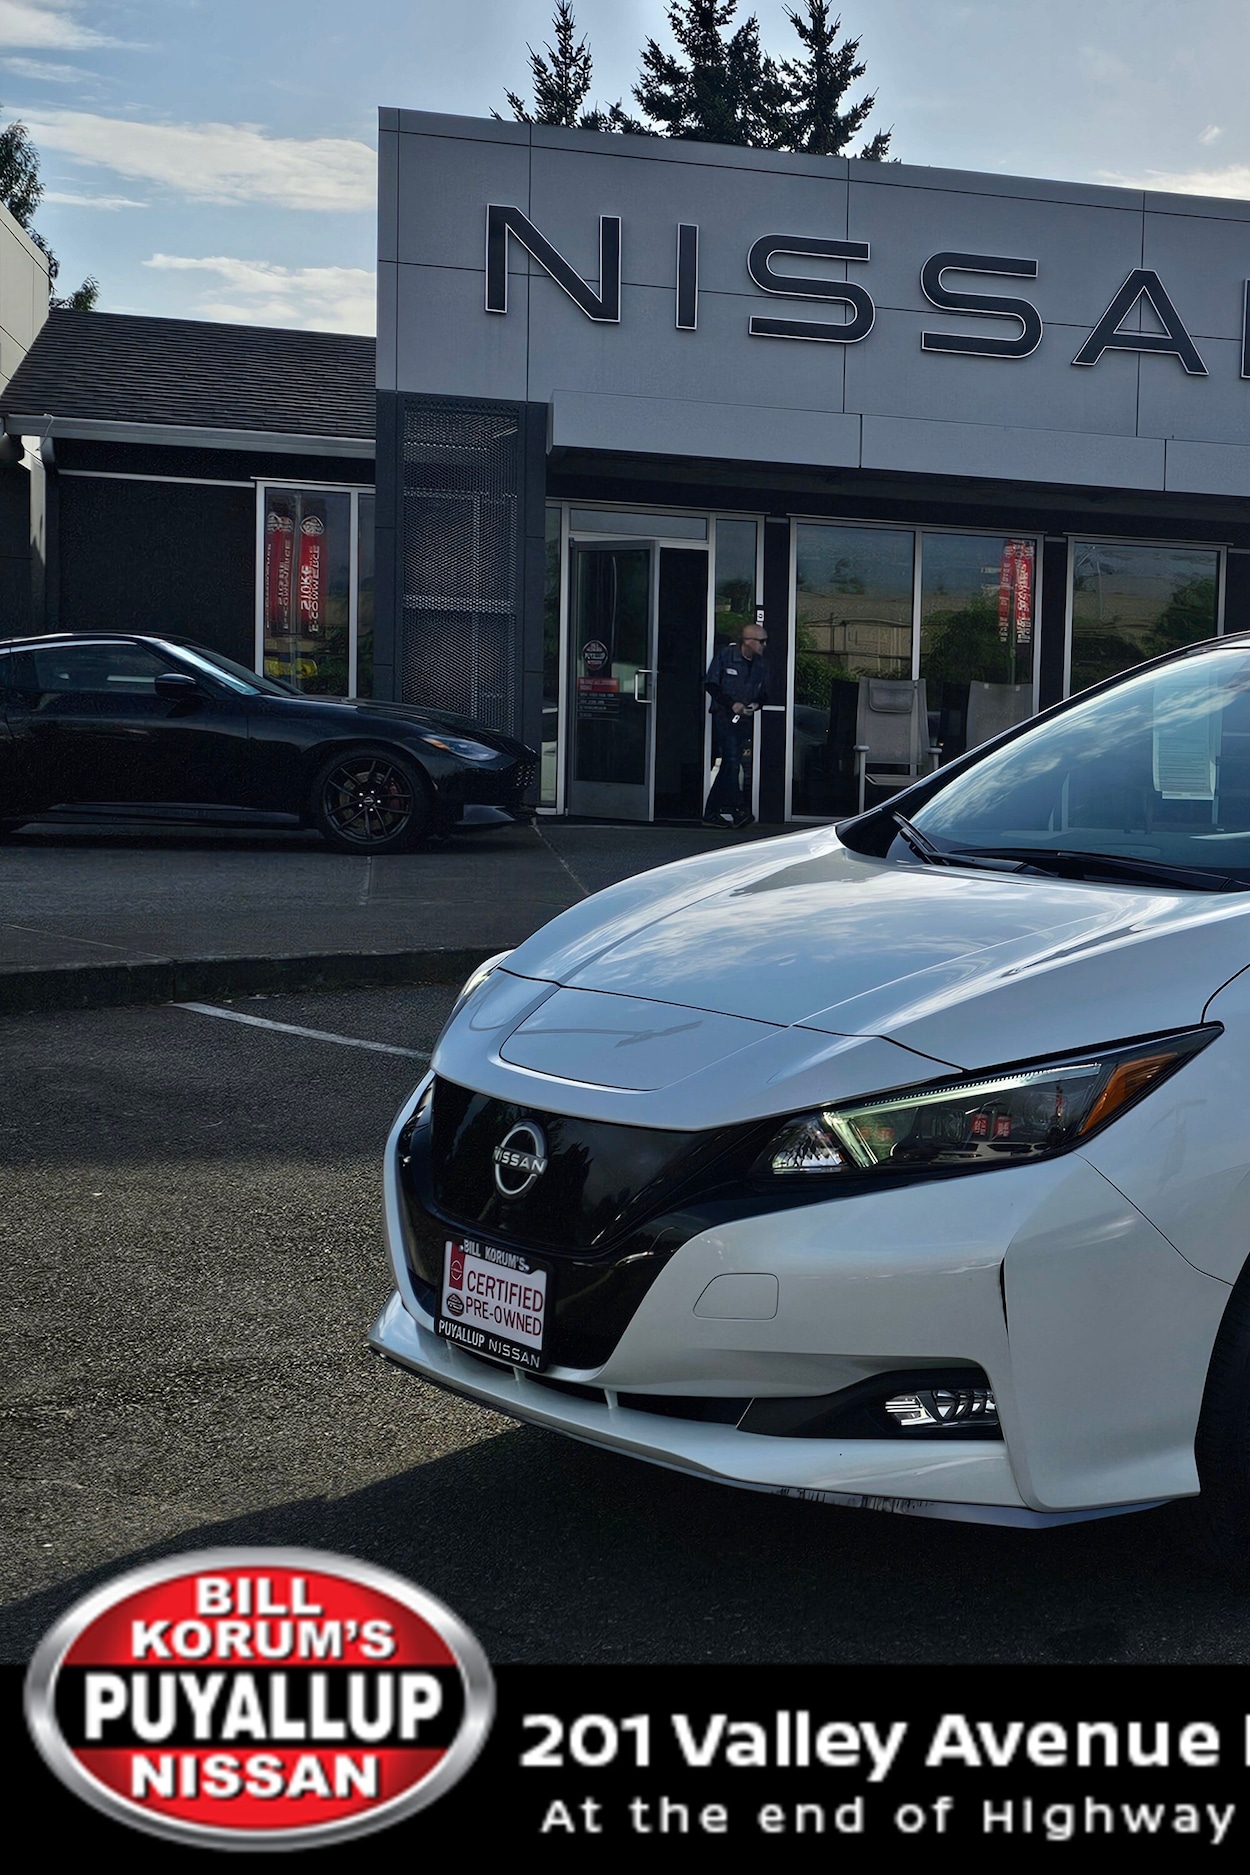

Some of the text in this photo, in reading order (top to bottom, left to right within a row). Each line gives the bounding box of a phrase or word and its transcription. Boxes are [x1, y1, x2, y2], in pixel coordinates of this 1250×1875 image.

[493, 1146, 546, 1174] NISSAN
[463, 1239, 529, 1272] BILL KORUM'S
[467, 1270, 544, 1313] CERTIFIED
[465, 1296, 543, 1337] PRE-OWNED
[438, 1320, 541, 1369] PUYALLUP NISSAN
